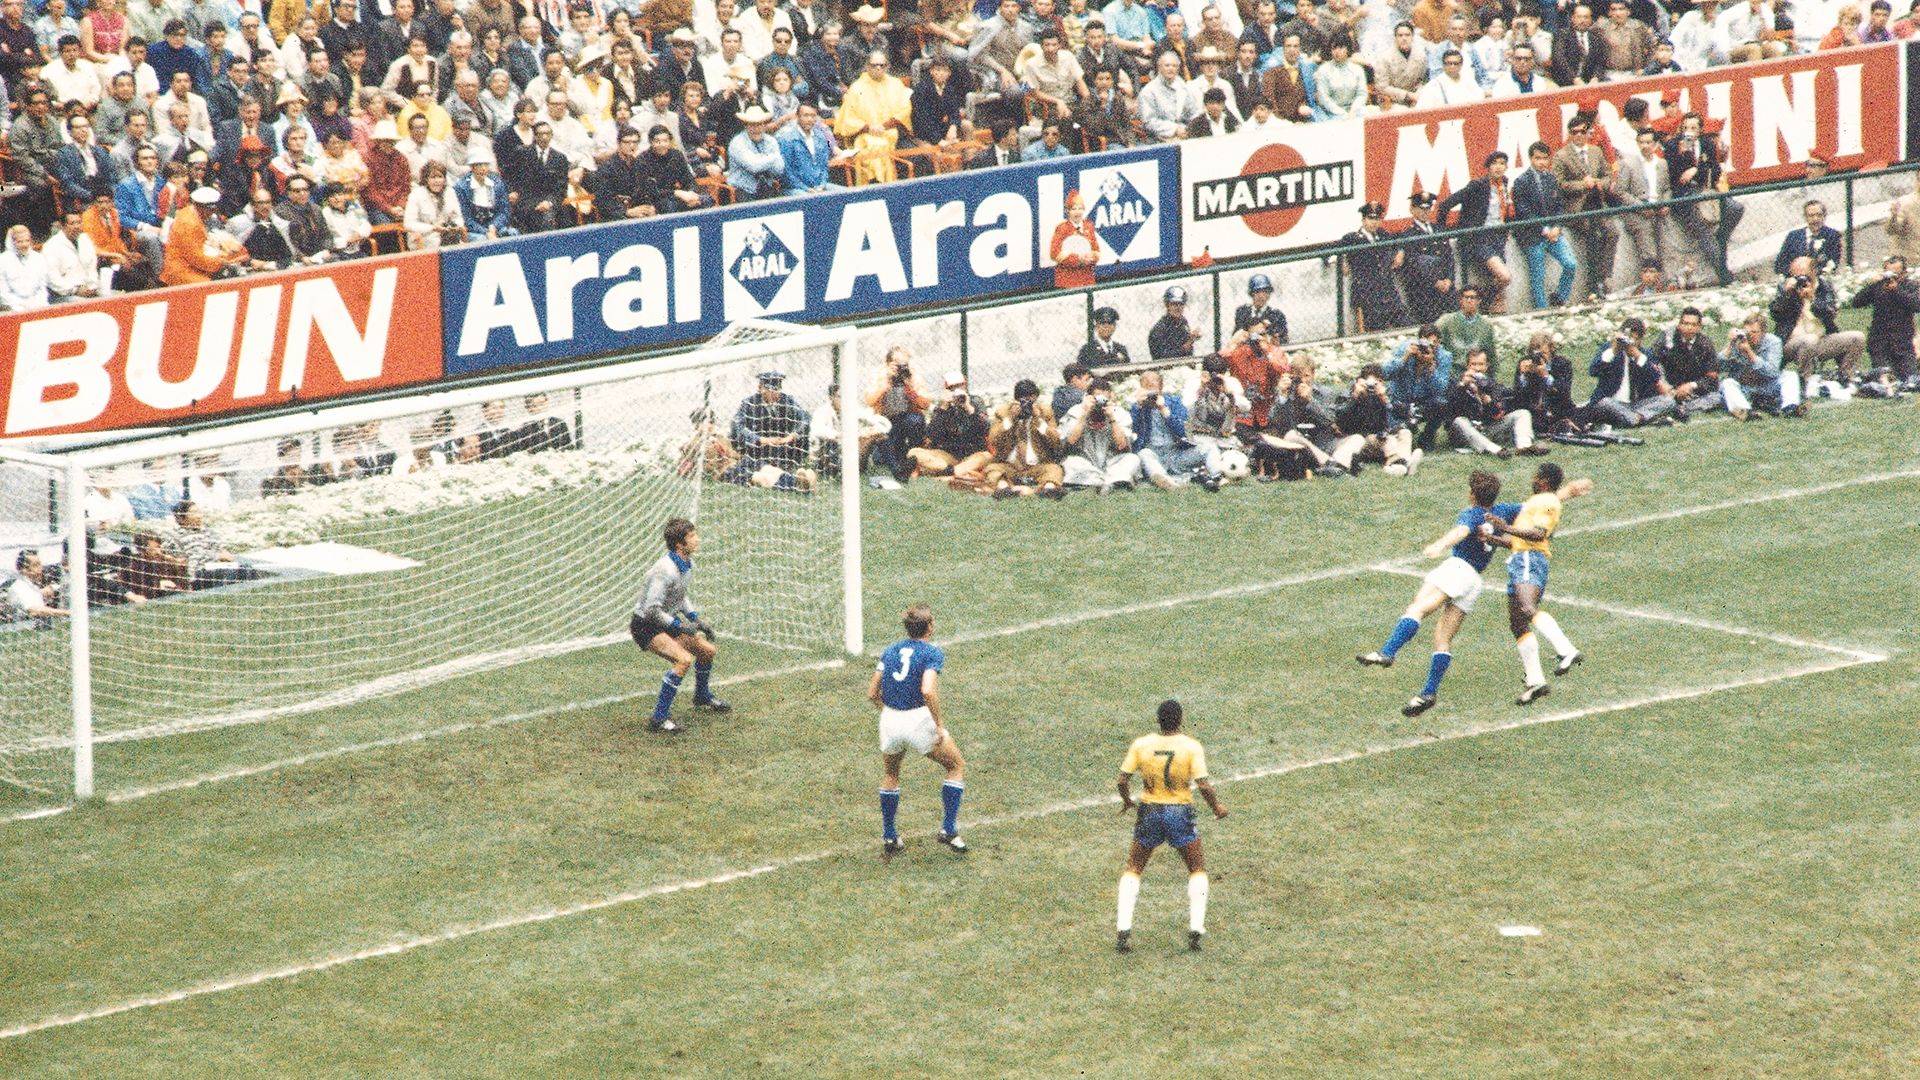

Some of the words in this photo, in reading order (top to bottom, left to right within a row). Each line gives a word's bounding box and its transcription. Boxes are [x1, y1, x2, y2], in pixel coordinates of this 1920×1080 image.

[1384, 63, 1864, 220] MAINI
[1095, 200, 1147, 230] ARAL
[1199, 165, 1350, 217] MARTINI
[824, 173, 1065, 302] Aral
[457, 225, 701, 356] Aral
[738, 253, 791, 281] ARAL
[4, 266, 399, 434] BUIN
[892, 648, 914, 680] 3
[1154, 751, 1175, 790] 7
